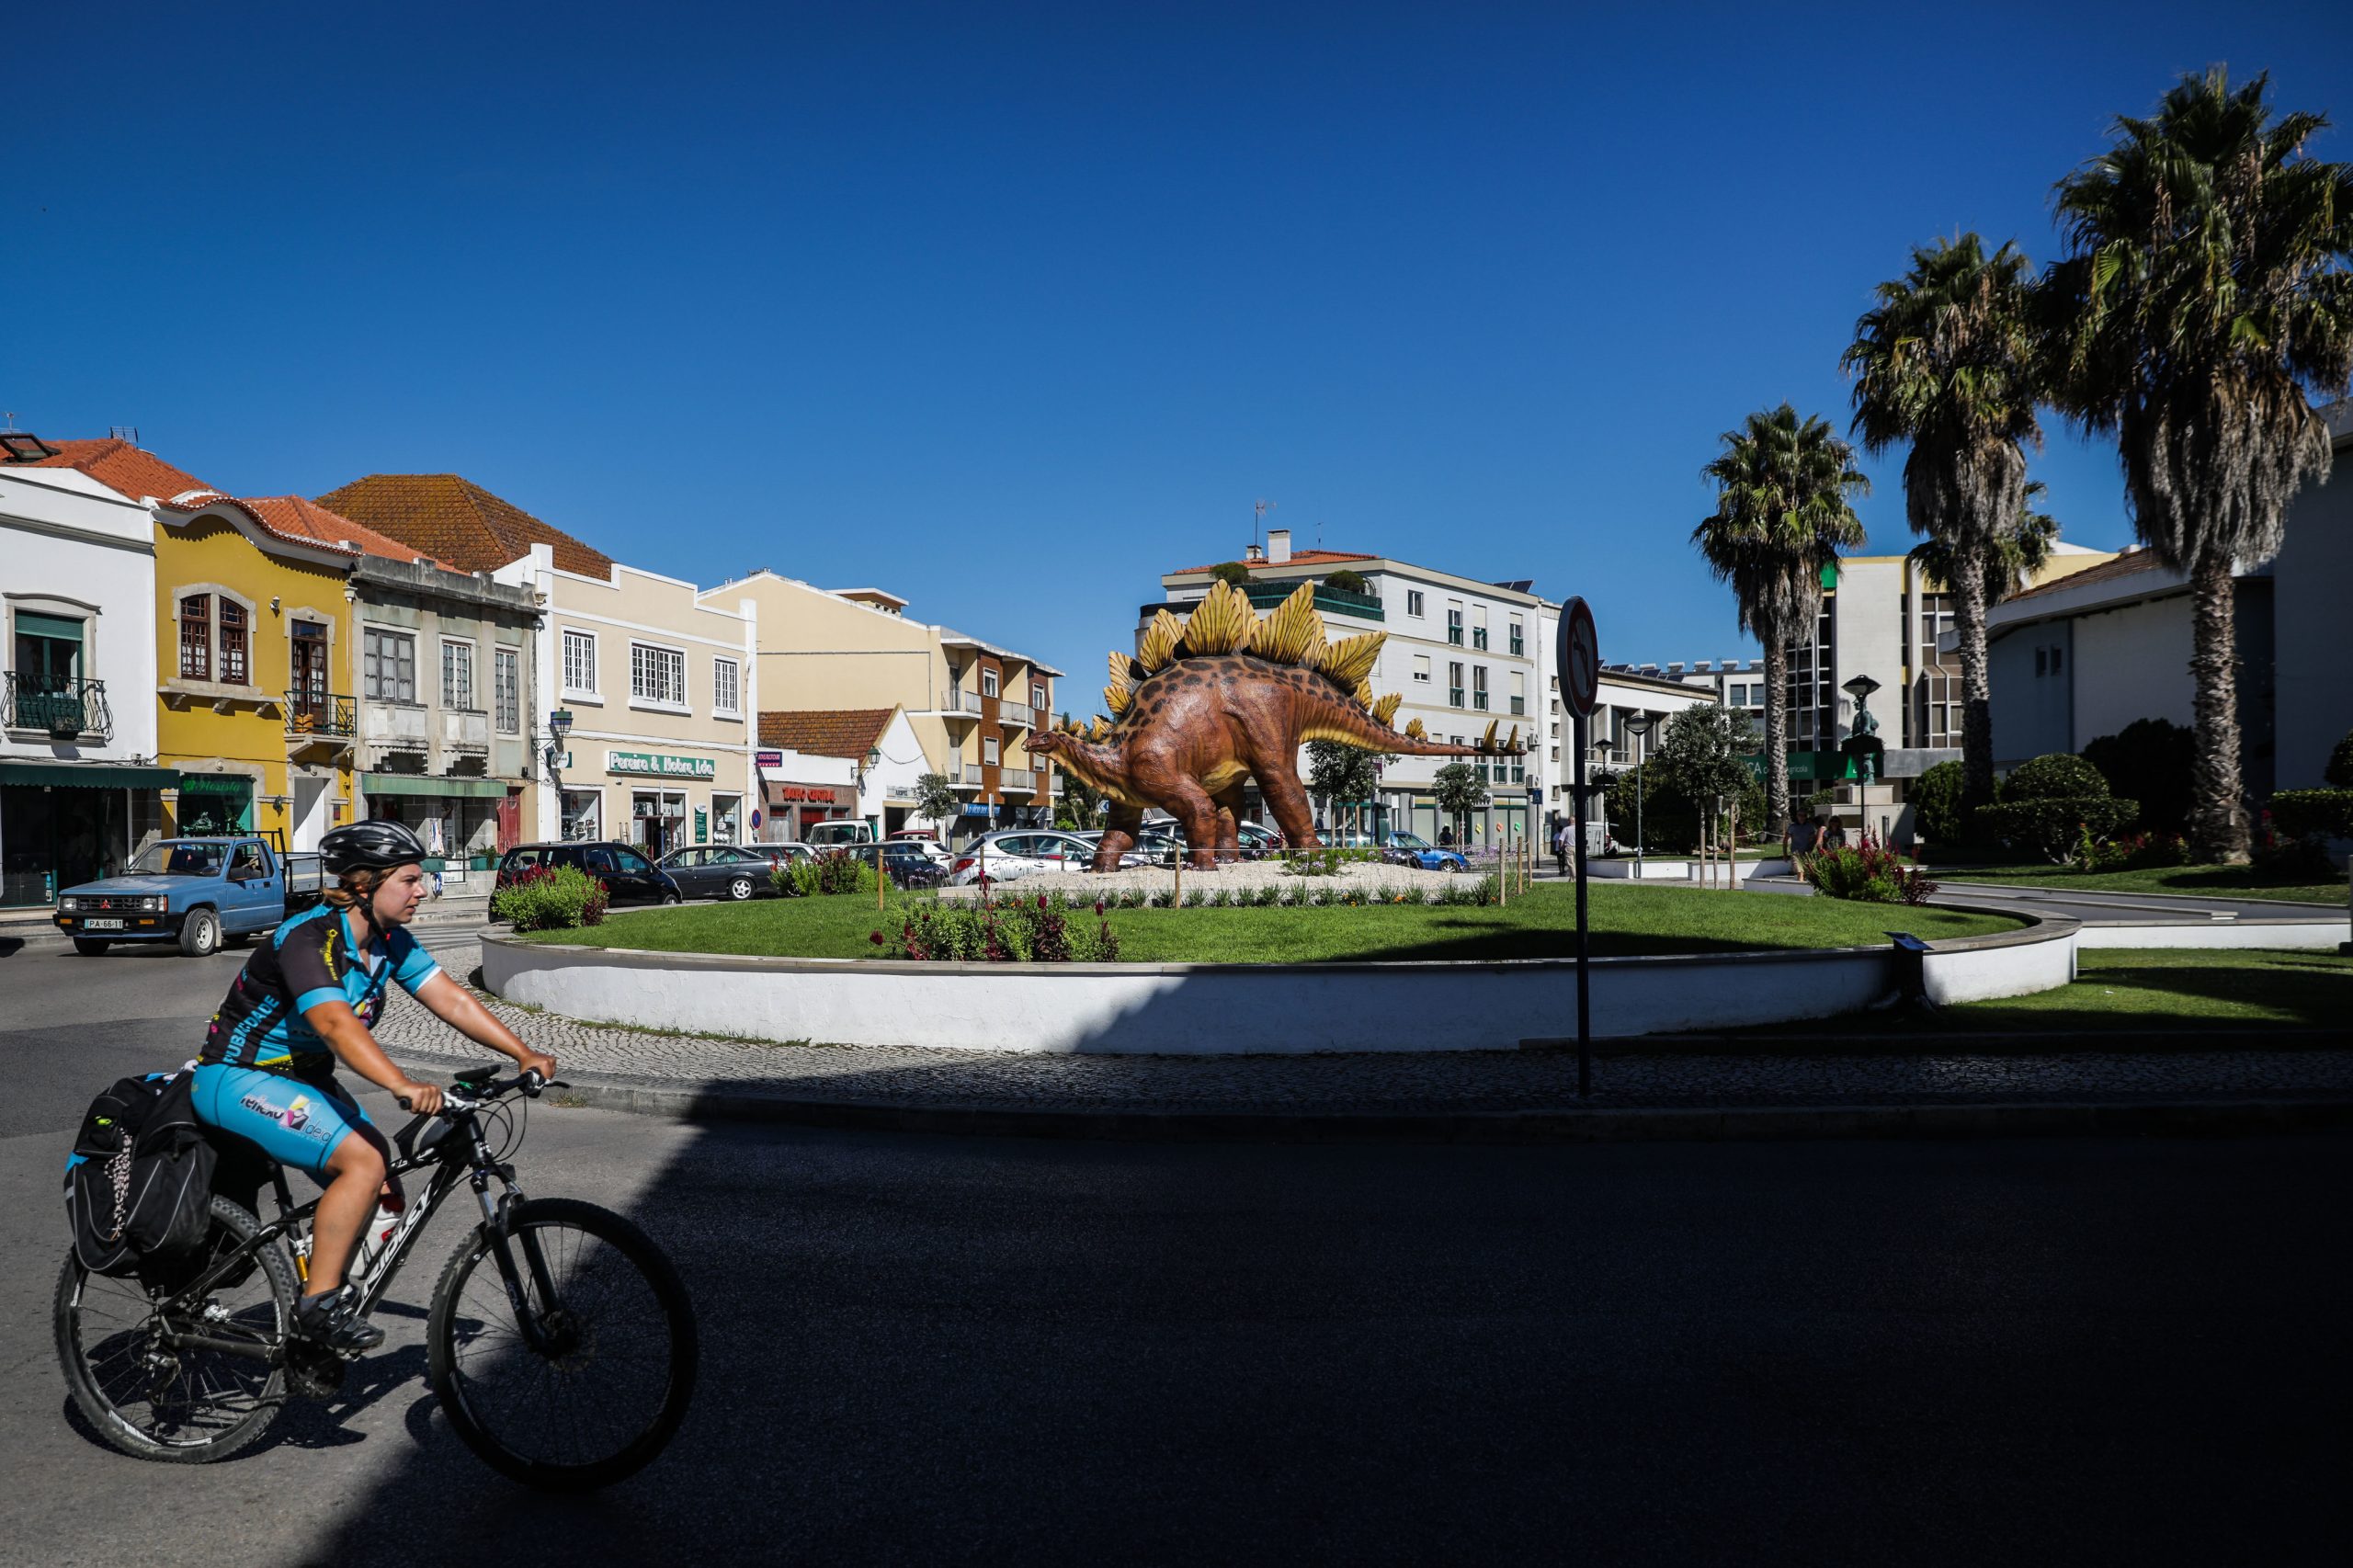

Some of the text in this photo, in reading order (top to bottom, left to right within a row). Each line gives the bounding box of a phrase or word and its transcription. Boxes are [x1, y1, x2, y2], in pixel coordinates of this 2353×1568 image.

[610, 753, 714, 775] Pereira & Nobre, Lda.
[301, 1118, 333, 1142] ideia
[362, 1182, 432, 1297] RIDLEY
